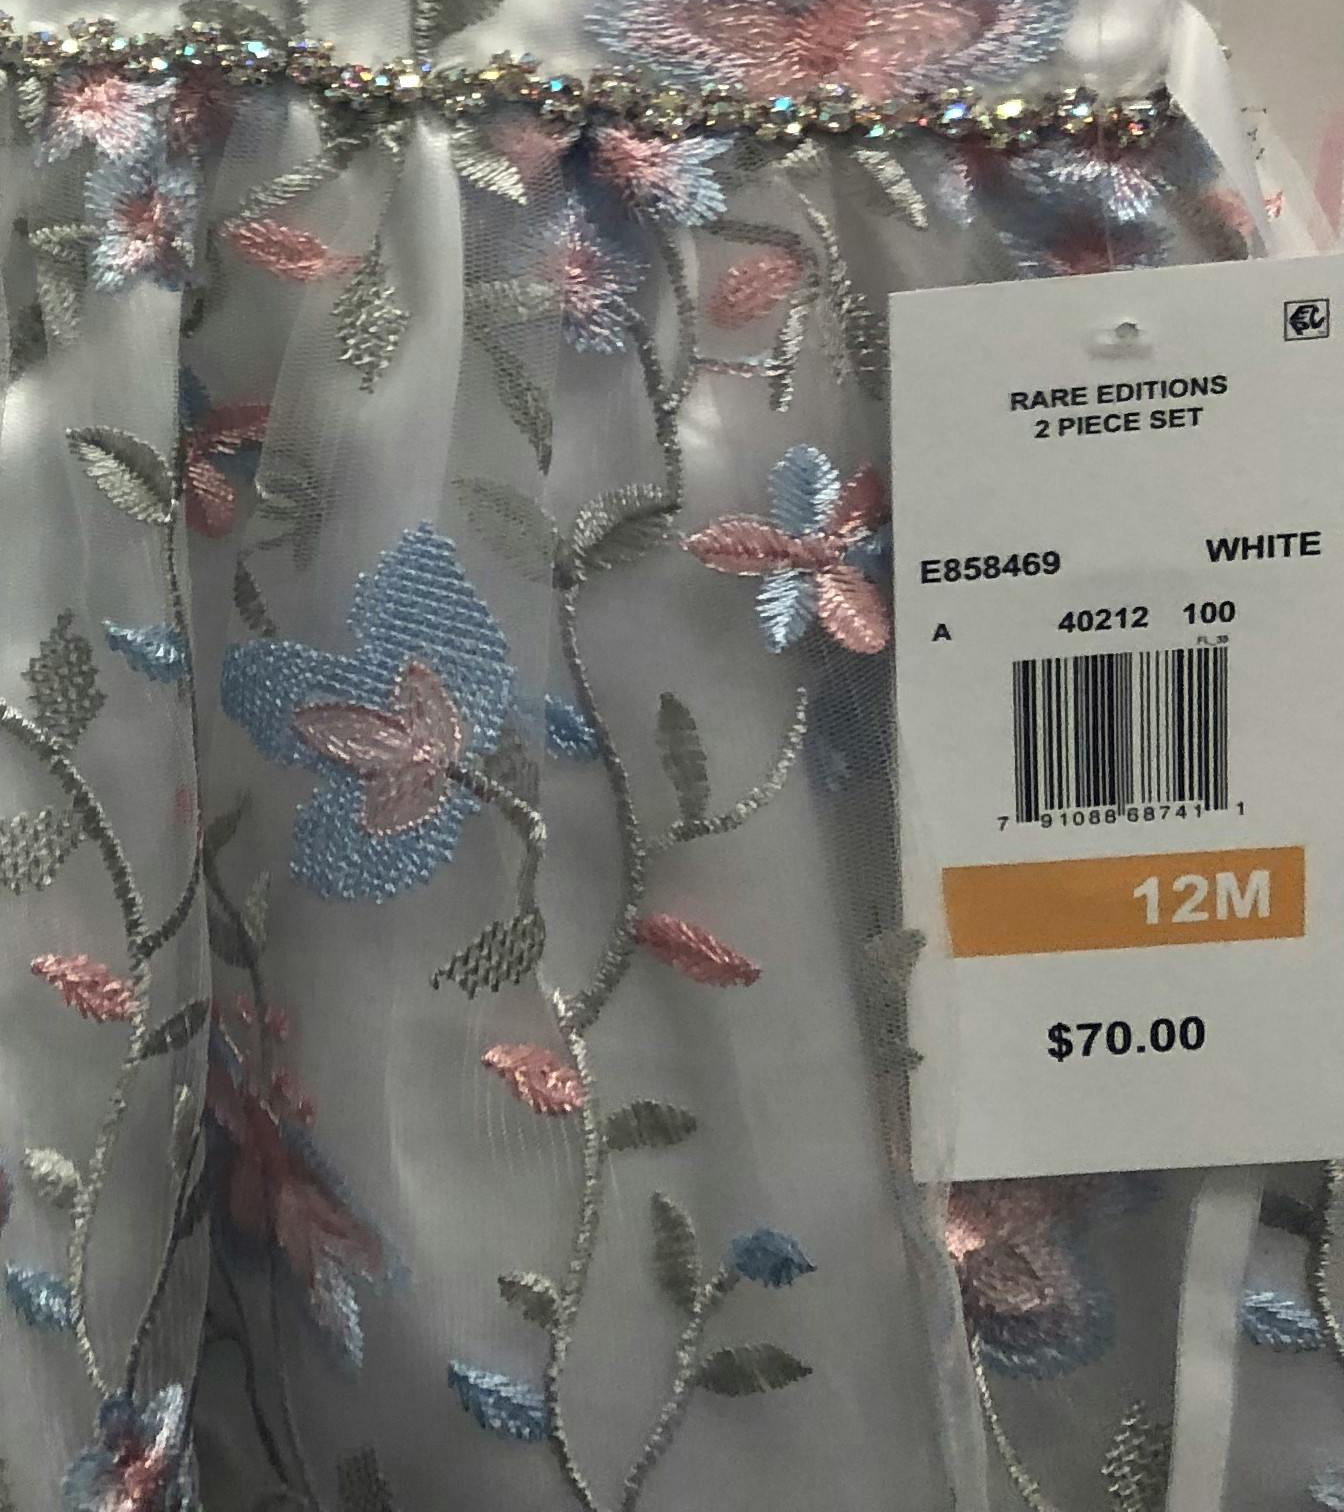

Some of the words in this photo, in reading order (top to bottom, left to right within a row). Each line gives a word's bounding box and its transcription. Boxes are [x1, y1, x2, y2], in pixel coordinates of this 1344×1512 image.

[1010, 386, 1088, 411] RARE
[1097, 375, 1228, 405] EDITIONS
[1033, 419, 1050, 439] 2
[1058, 412, 1140, 437] PIECE
[1149, 407, 1204, 430] SET
[920, 550, 1061, 584] E858469
[1206, 531, 1322, 563] WHITE
[932, 623, 952, 642] A
[1058, 605, 1150, 633] 40212
[1182, 600, 1236, 625] 100
[996, 815, 1010, 832] 7
[1040, 809, 1117, 829] 91088
[1127, 800, 1204, 823] 68741
[1237, 801, 1246, 816] 1
[1133, 870, 1271, 925] 12M
[1047, 1016, 1205, 1063] $70.00
